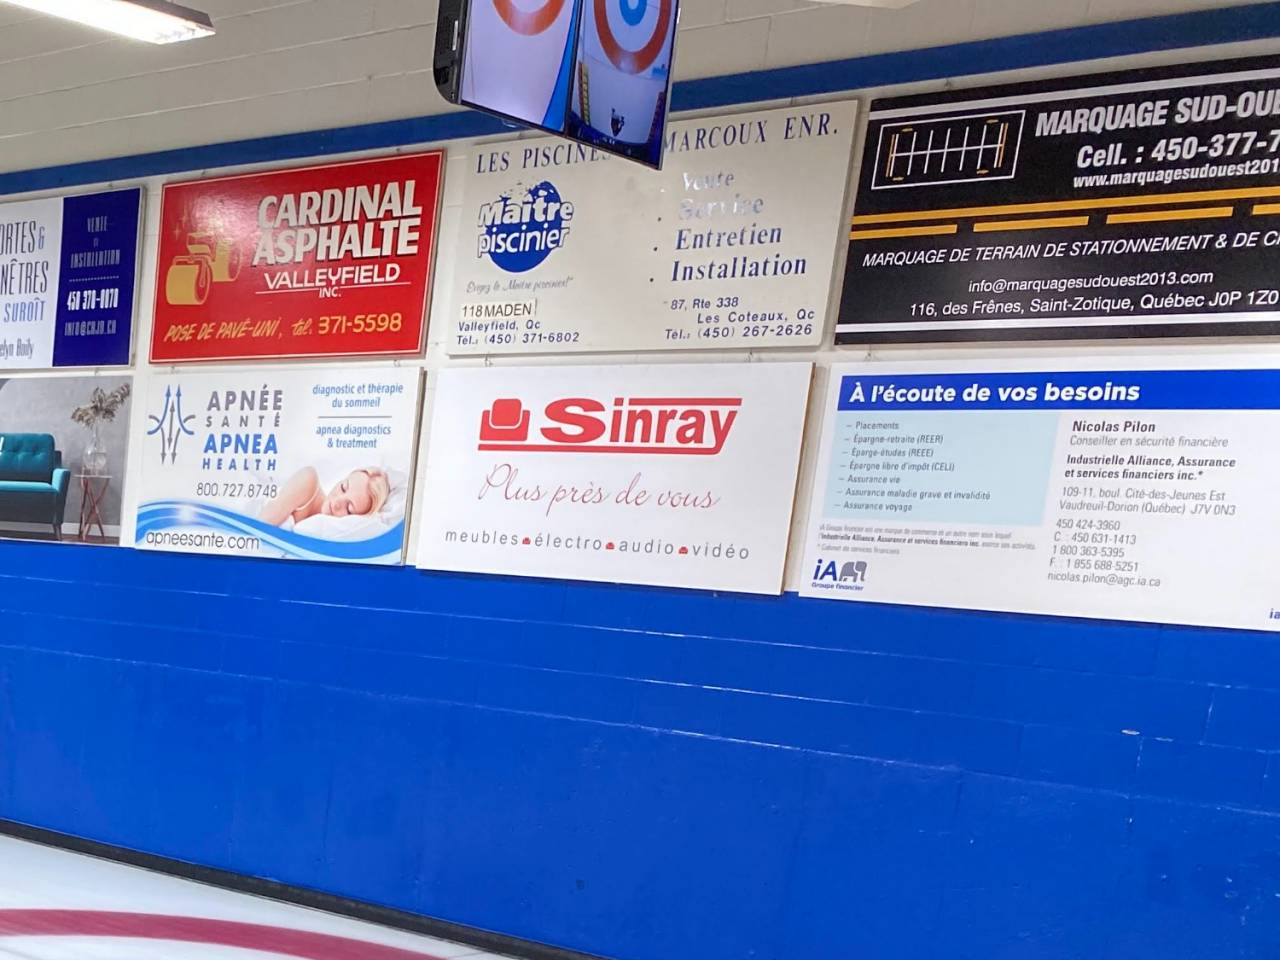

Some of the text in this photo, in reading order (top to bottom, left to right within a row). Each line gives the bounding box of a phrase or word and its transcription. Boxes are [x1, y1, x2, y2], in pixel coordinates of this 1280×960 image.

[1035, 100, 1170, 137] MARQUAGE
[477, 113, 838, 173] LES PISCINE MARCOUX ENR.
[1077, 130, 1280, 169] Cell. 450-377-7
[257, 180, 423, 229] CARDINAL
[251, 218, 422, 267] ASPHALTE
[477, 222, 570, 258] piscinier
[675, 222, 782, 250] Entretien
[862, 232, 1260, 267] MARQUAGE DE TERRAIN DE STATIONNEMENT & DE
[671, 253, 807, 282] Installation
[264, 263, 401, 290] VALLEYFIELD
[968, 270, 1213, 294] info@marquagesudouest2013.com
[319, 286, 342, 298] INC.
[3, 298, 46, 323] SUROÎT
[692, 297, 739, 309] Rte 338
[909, 290, 1279, 317] 116, des Frênes, Saint-Zotique, Québec J0P 1Z0
[698, 309, 815, 324] Les Coteaux, Qc
[164, 323, 197, 342] POSE
[200, 323, 217, 339] DE
[318, 312, 402, 335] 371-5598
[459, 320, 541, 332] Valleyfield, Qc
[697, 324, 812, 339] (450) 267-2626
[485, 332, 580, 345] (450) 371-6802
[312, 383, 403, 396] diagnostic et thérapie
[849, 382, 1140, 402] À l'écoute de vos besoins
[207, 384, 284, 412] APNÉE
[331, 396, 381, 408] du sommeil
[205, 412, 281, 428] SANTÉ
[539, 397, 739, 454] Sinray
[855, 421, 899, 430] Placements
[1072, 421, 1156, 433] Nicolas Pilon
[316, 424, 392, 437] apnea diagnostics
[203, 433, 279, 454] APNEA
[327, 437, 377, 449] & treatment
[1070, 435, 1229, 447] Conseiller en sécurité financière
[202, 458, 277, 471] HEALTH
[1067, 455, 1236, 468] Industrielle Alliance, Assurance
[847, 475, 887, 483] Assurance
[1065, 469, 1174, 480] et services financiers
[196, 482, 278, 499] 800.727.8748
[478, 463, 720, 517] Plus près de vous
[845, 488, 918, 498] Assurance maladie
[1125, 488, 1226, 501] Cité-des-Jeunes Est
[844, 501, 883, 511] Assurance
[1059, 500, 1185, 515] Vaudreuil-Dorion (Québec)
[1056, 519, 1120, 531] 450 424-3960
[146, 529, 260, 550] apneesante.com
[445, 528, 750, 560] meubles électro audio vidéo
[1071, 532, 1136, 545] 450 631-1413
[1080, 546, 1125, 557] 363-5395
